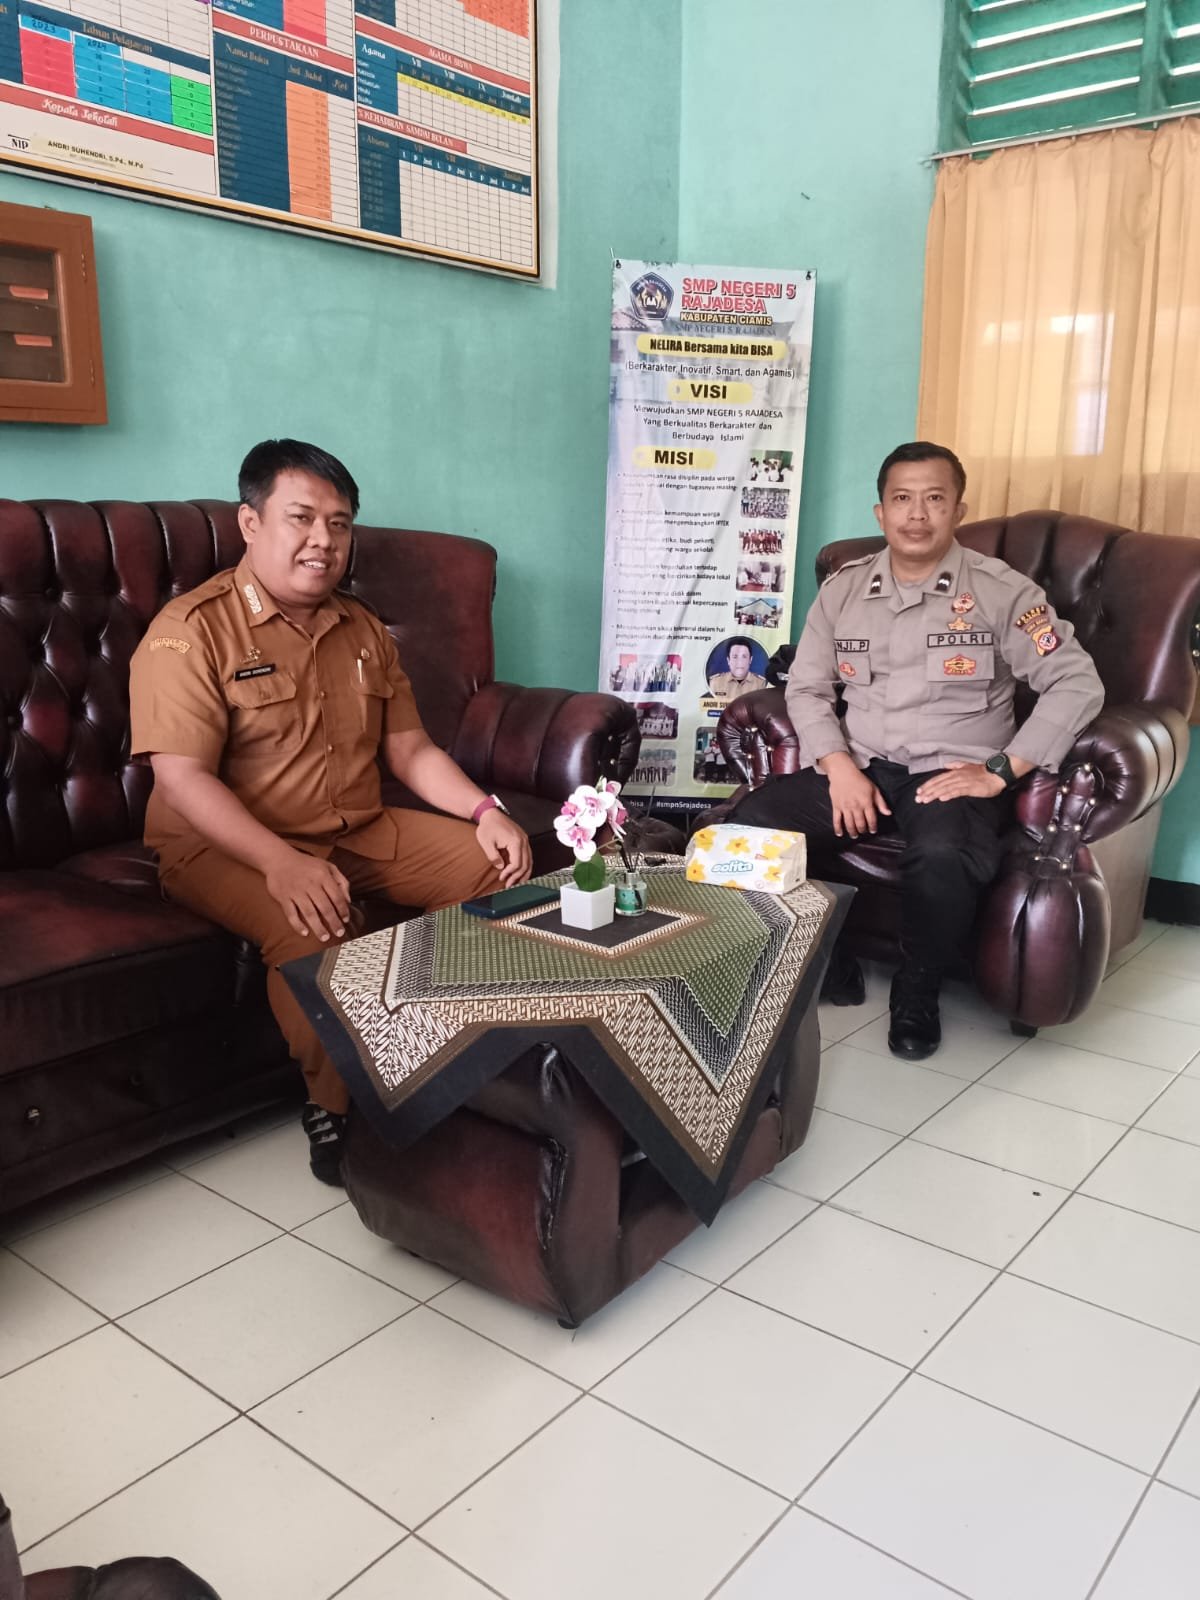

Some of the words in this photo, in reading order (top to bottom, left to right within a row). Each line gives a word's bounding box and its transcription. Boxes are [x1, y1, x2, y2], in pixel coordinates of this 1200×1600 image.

[31, 18, 56, 34] 2023
[249, 26, 320, 58] PERPUSTAKAAN
[361, 43, 386, 60] Agama
[11, 138, 29, 150] NIP
[47, 140, 70, 151] ANDRI
[682, 277, 718, 296] SMP
[721, 280, 782, 299] NEGERI
[786, 284, 797, 299] 5
[681, 294, 767, 314] RAJADESA
[680, 312, 737, 325] KABUPATEN
[739, 316, 773, 326] CIAMIS
[650, 338, 683, 353] NELIRA
[684, 341, 728, 355] Bersama
[730, 343, 749, 355] kita
[750, 344, 774, 356] BISA
[745, 367, 761, 377] dan
[763, 367, 796, 380] Agamis)
[690, 383, 728, 400] VISI
[633, 405, 685, 416] Mewujudkan
[686, 408, 705, 417] SMP
[706, 409, 737, 418] NEGERI
[744, 410, 783, 419] RAJADESA
[642, 417, 662, 428] Yang
[663, 418, 708, 429] Berkualitas
[709, 420, 756, 430] Berkarakter
[758, 421, 773, 431] dan
[672, 431, 715, 442] Berbudaya
[720, 433, 745, 442] Islami
[654, 450, 694, 466] MISI
[664, 473, 677, 481] rasa
[700, 473, 716, 482] pada
[665, 482, 688, 491] dengan
[664, 509, 701, 518] kemampuan
[859, 641, 866, 650] P
[937, 634, 985, 645] POLRI
